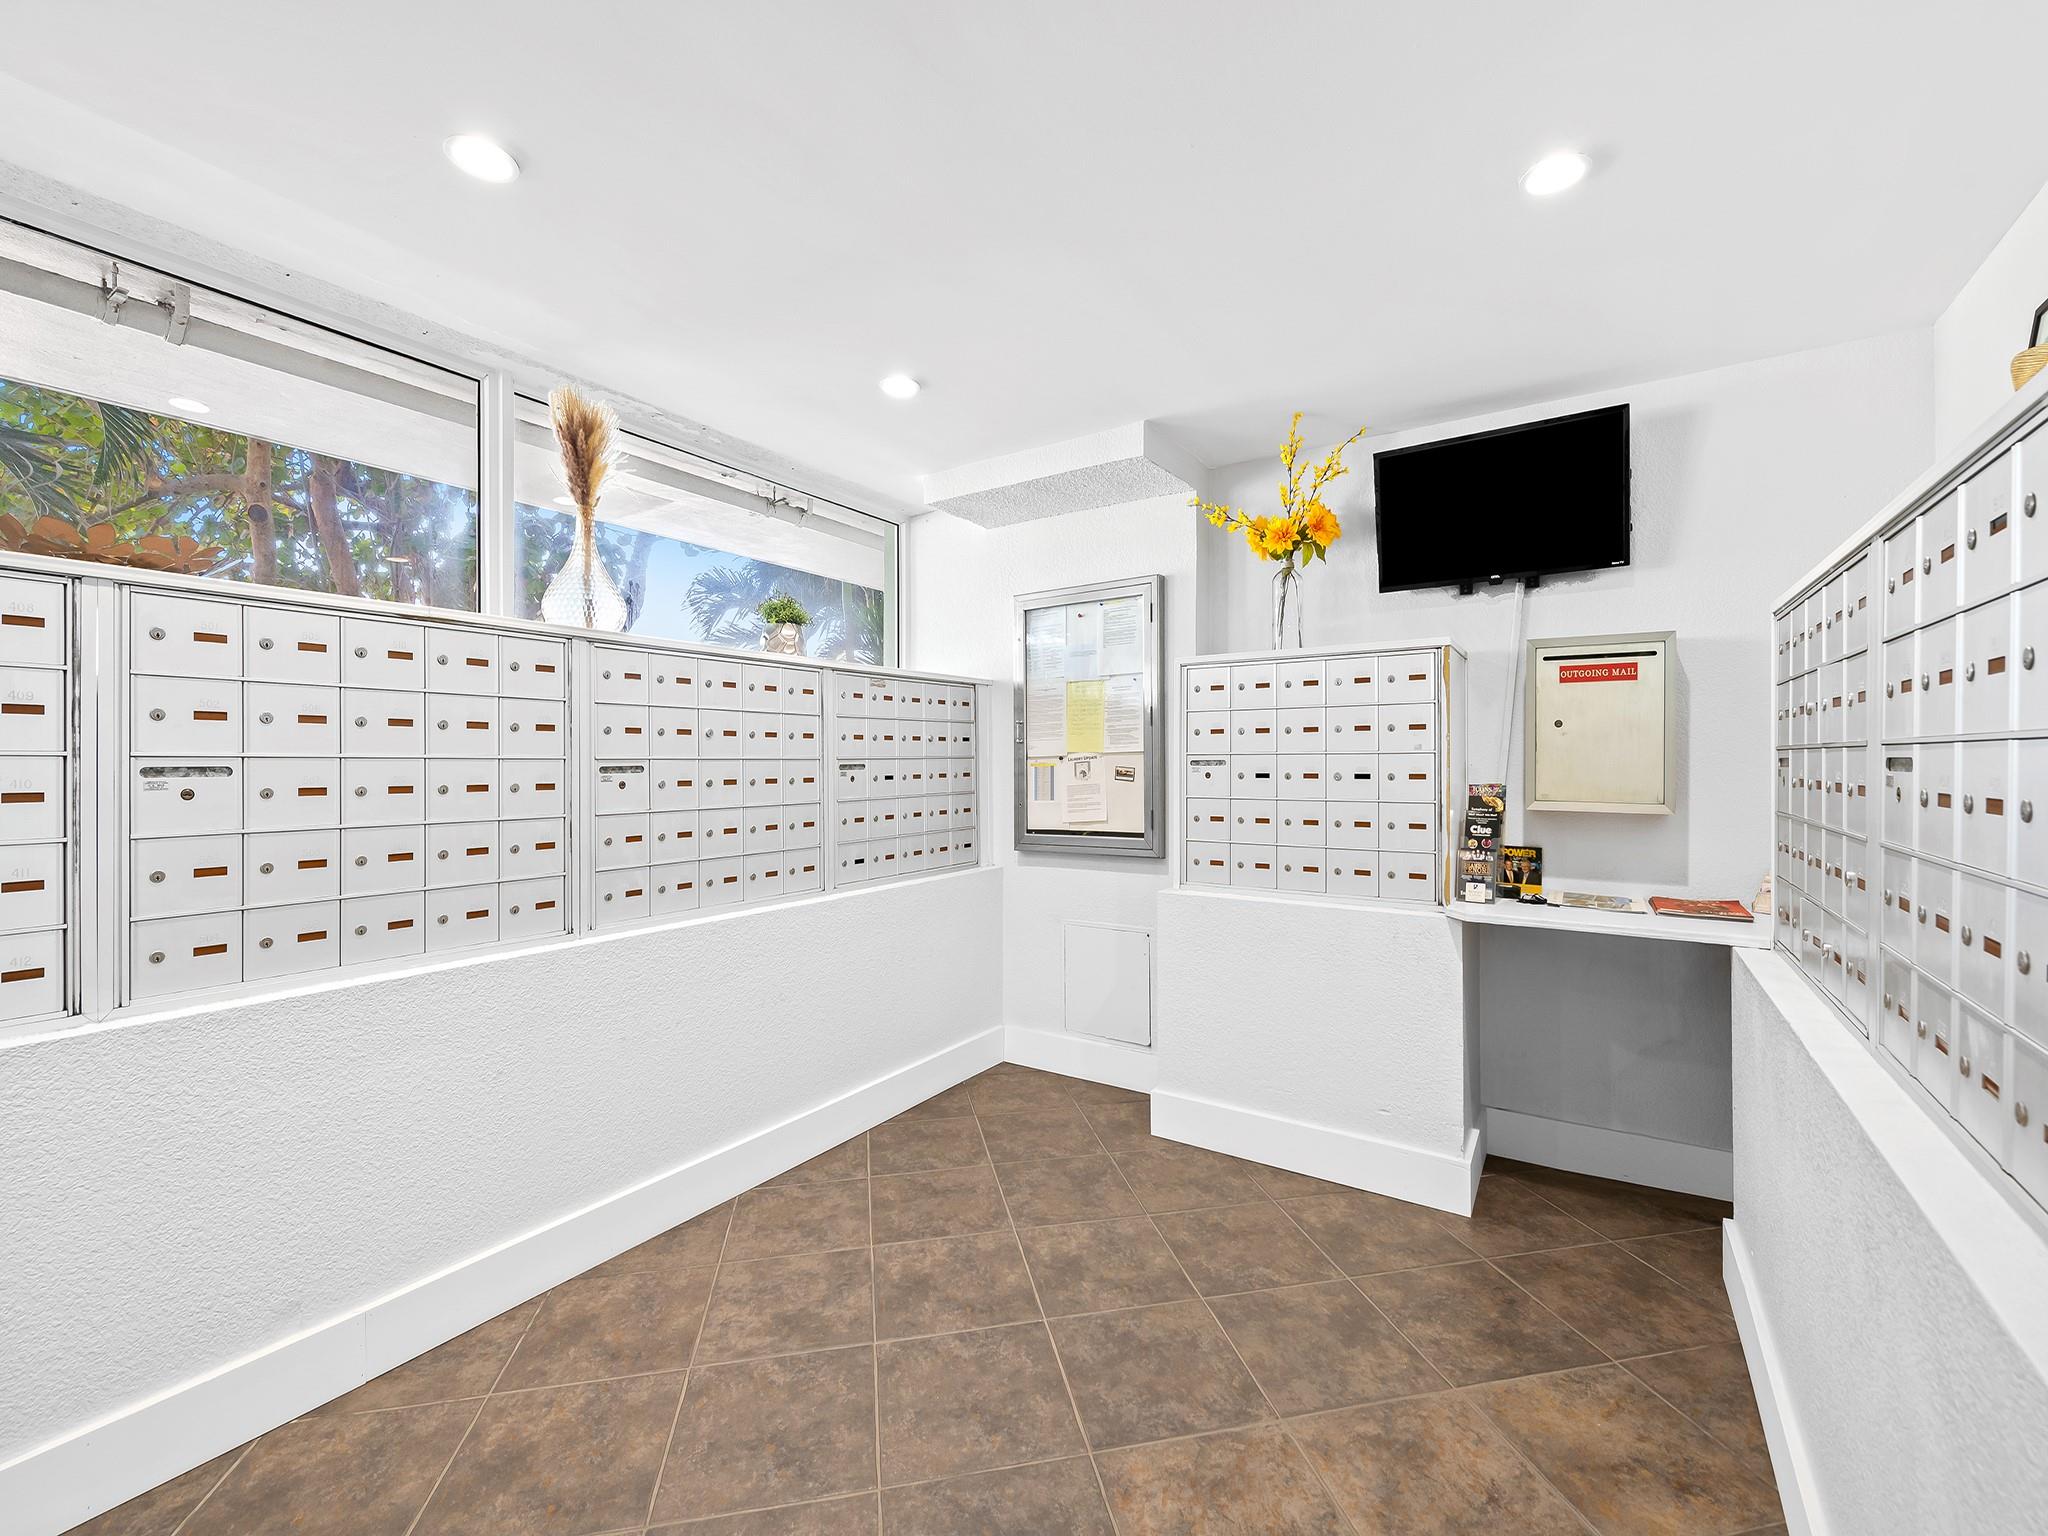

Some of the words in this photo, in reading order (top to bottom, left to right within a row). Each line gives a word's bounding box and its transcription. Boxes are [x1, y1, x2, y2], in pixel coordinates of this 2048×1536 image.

[8, 601, 35, 613] 408
[1560, 668, 1609, 679] OUTGOING
[1612, 667, 1637, 676] MAIL
[7, 689, 35, 701] 409
[9, 778, 33, 789] 410
[1470, 825, 1492, 834] Clue
[1502, 848, 1537, 858] POWER
[11, 867, 31, 878] 411
[9, 955, 33, 967] 412
